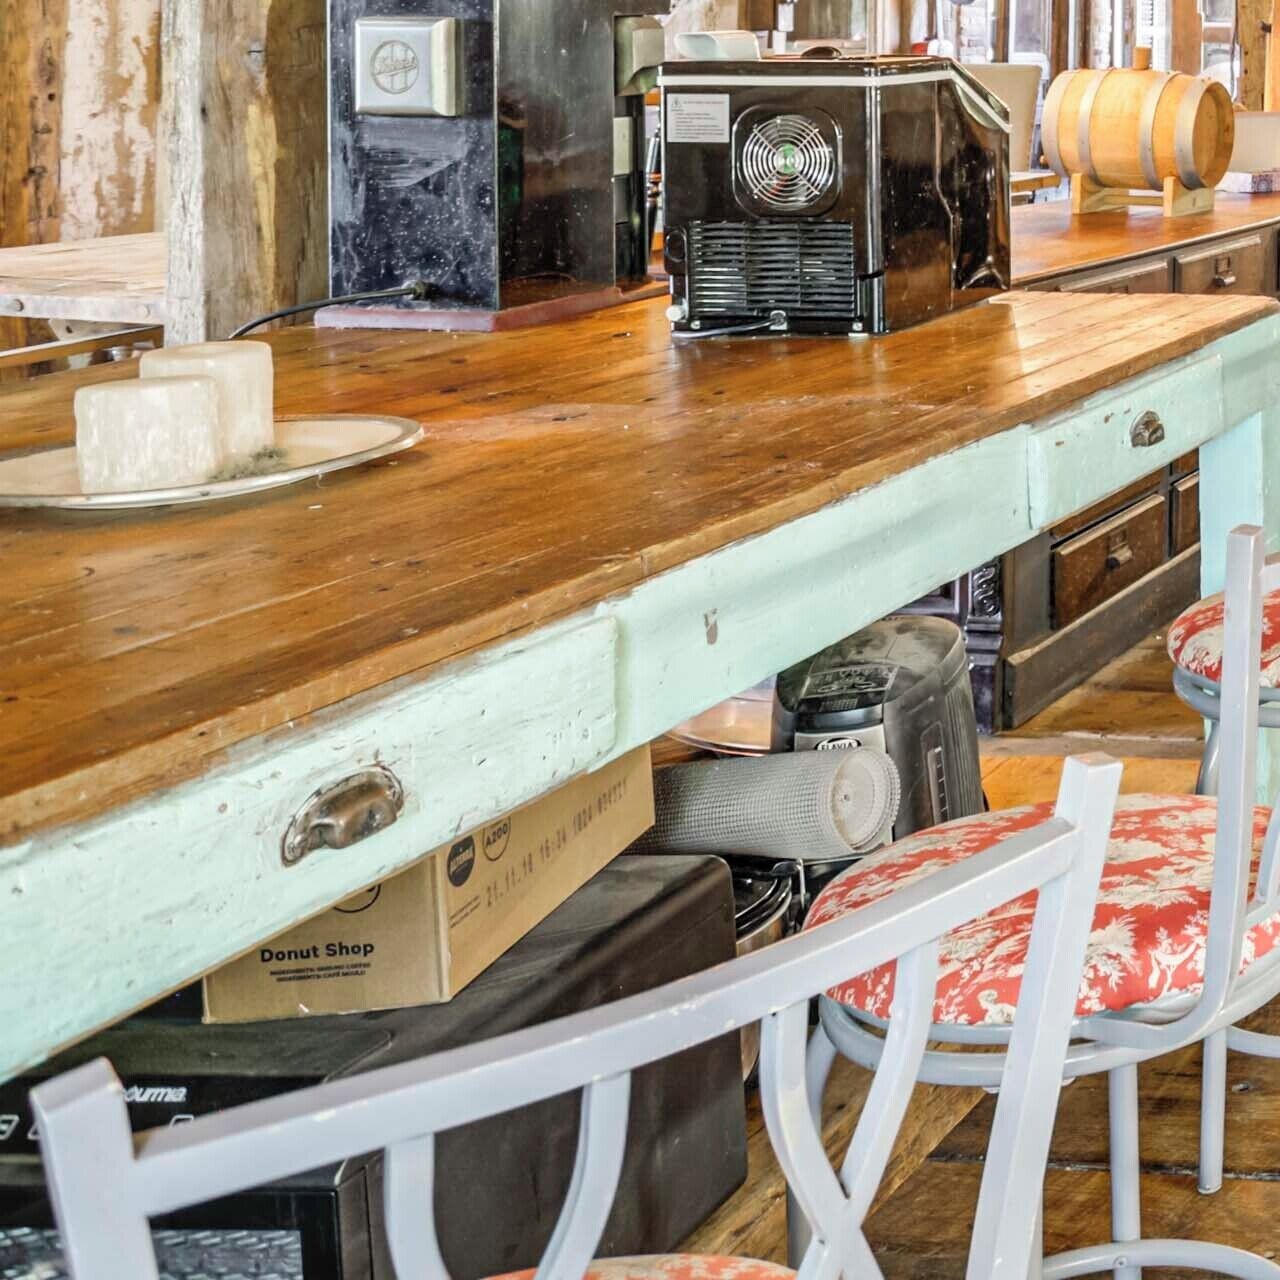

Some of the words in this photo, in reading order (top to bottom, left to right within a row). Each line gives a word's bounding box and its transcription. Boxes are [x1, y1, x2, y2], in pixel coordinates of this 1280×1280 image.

[260, 945, 320, 962] Donut
[325, 941, 375, 957] Shop
[121, 1086, 187, 1102] ourmia
